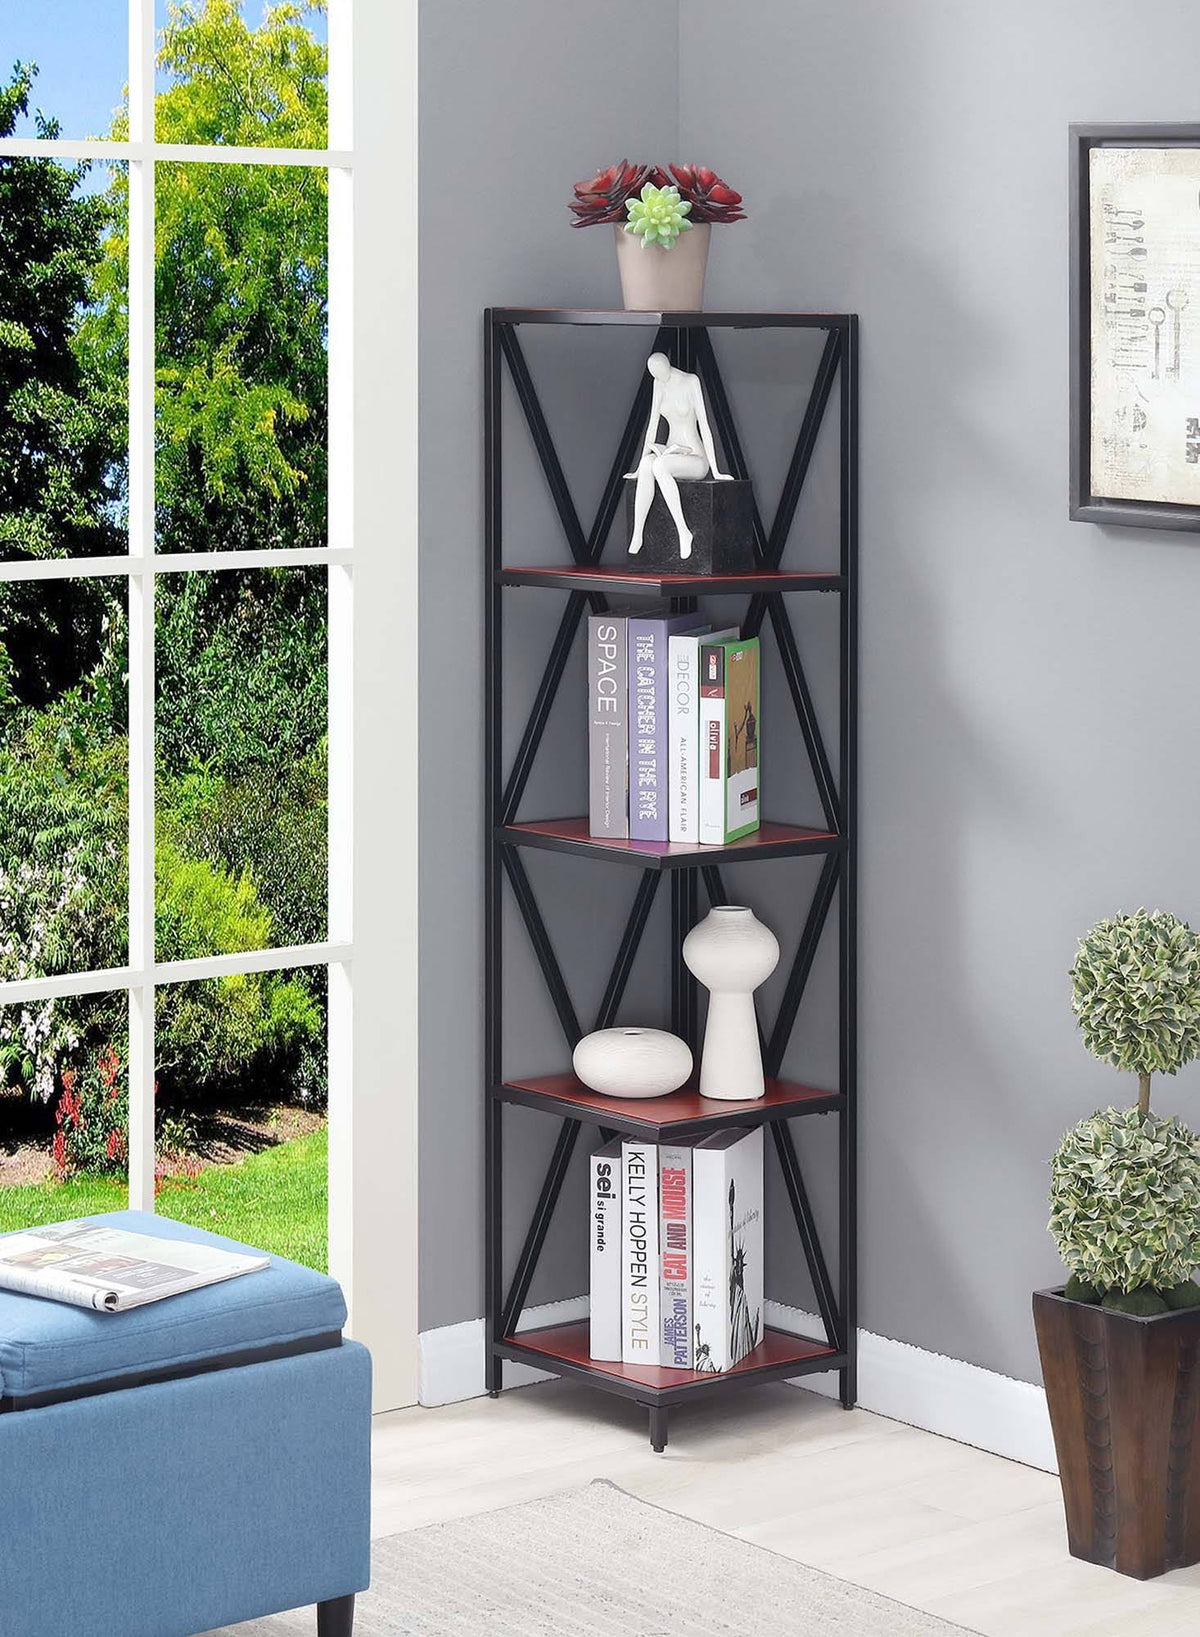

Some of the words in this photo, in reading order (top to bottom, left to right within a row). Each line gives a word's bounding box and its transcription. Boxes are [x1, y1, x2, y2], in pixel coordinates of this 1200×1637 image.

[636, 634, 655, 662] THE
[597, 625, 617, 712] SPACE
[637, 666, 656, 735] CATCHER
[677, 662, 690, 714] DECOR
[638, 738, 656, 755] IN
[709, 721, 719, 750] olivia
[638, 759, 657, 787] THE
[639, 791, 657, 820] RYE
[597, 1163, 616, 1199] sei
[628, 1152, 645, 1206] KELLY
[662, 1167, 686, 1220] MOUSE
[597, 1200, 606, 1211] si
[595, 1213, 606, 1252] grande
[629, 1212, 647, 1287] HOPPEN
[667, 1223, 686, 1250] AND
[663, 1252, 687, 1280] CAT
[631, 1293, 648, 1349] STYLE
[664, 1318, 675, 1348] JAMES
[673, 1299, 687, 1365] PATTERSON
